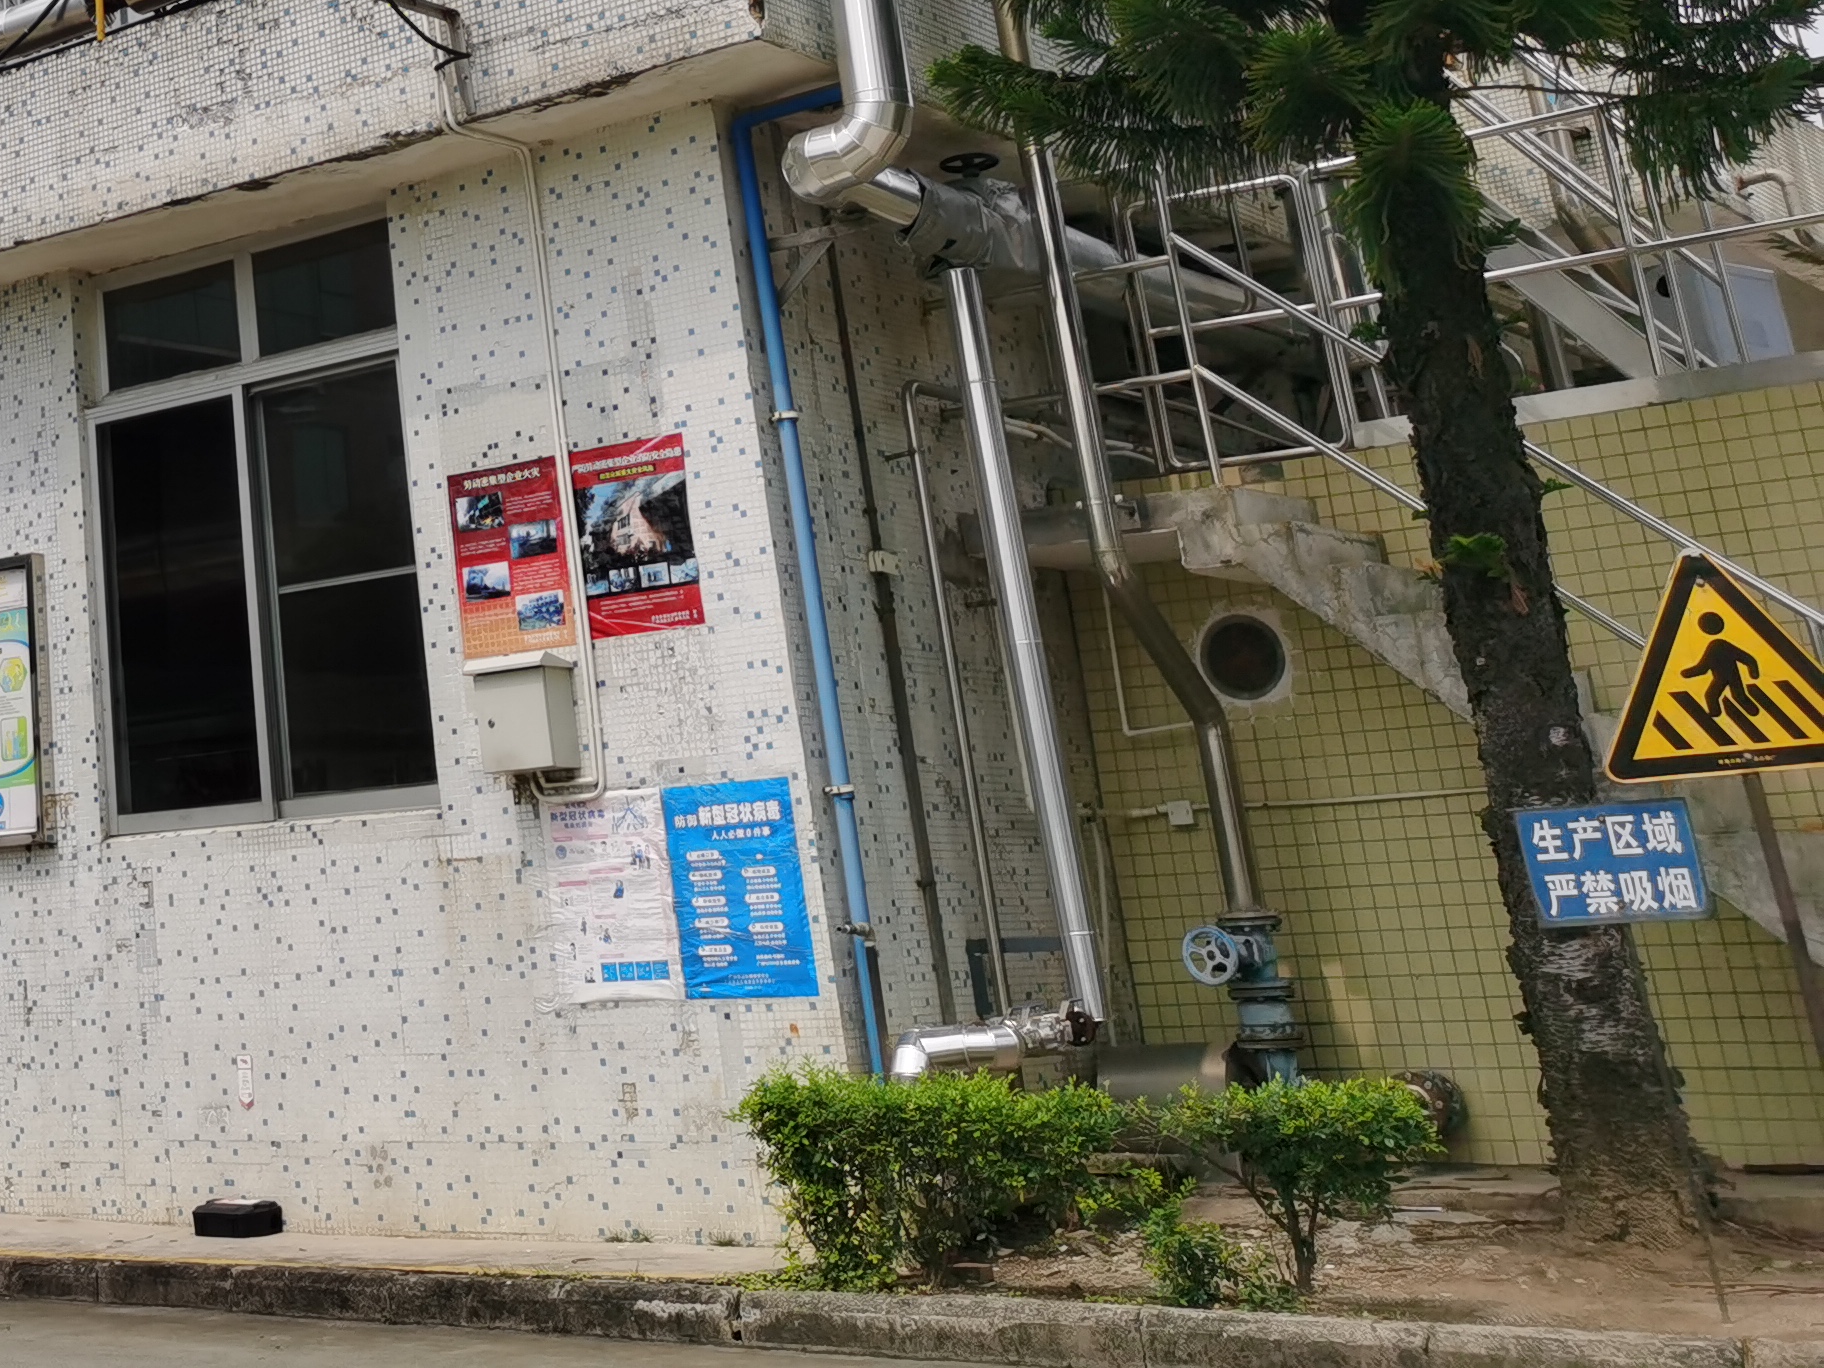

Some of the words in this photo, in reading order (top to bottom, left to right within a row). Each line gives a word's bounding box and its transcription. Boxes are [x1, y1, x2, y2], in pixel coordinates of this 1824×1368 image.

[1532, 810, 1683, 862] 生产区域
[1544, 867, 1698, 917] 严禁吸烟
